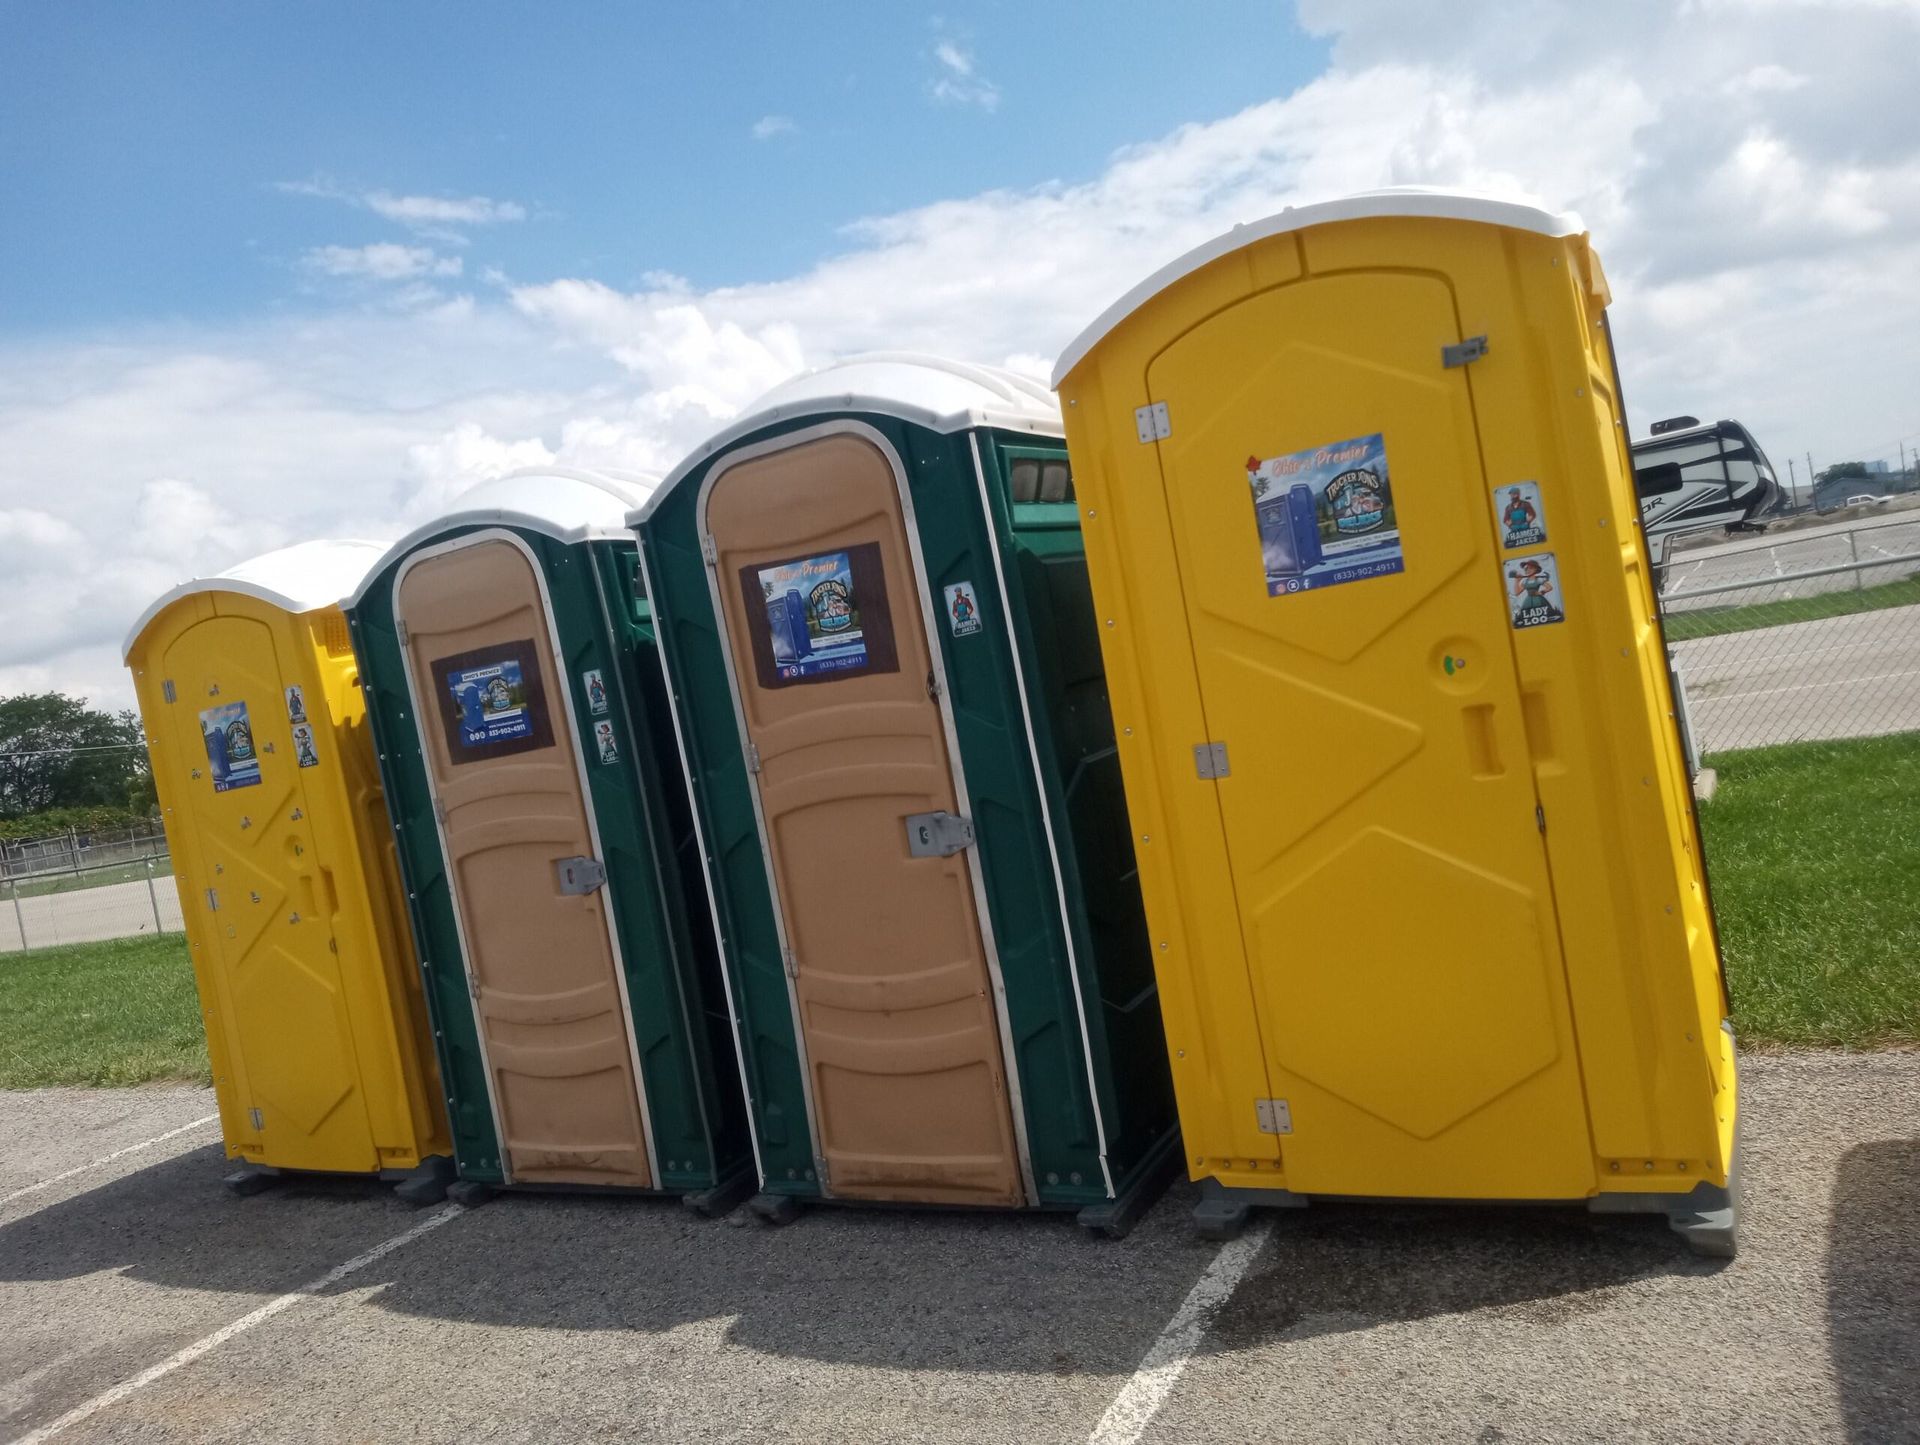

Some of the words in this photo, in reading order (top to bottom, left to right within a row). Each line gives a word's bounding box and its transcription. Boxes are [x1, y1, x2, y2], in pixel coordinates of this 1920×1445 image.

[1316, 445, 1369, 468] Premier
[1326, 472, 1356, 501] TRUCKER
[1333, 562, 1396, 581] (833)-902-4911
[1522, 606, 1549, 618] LADY
[1524, 615, 1548, 626] LOO
